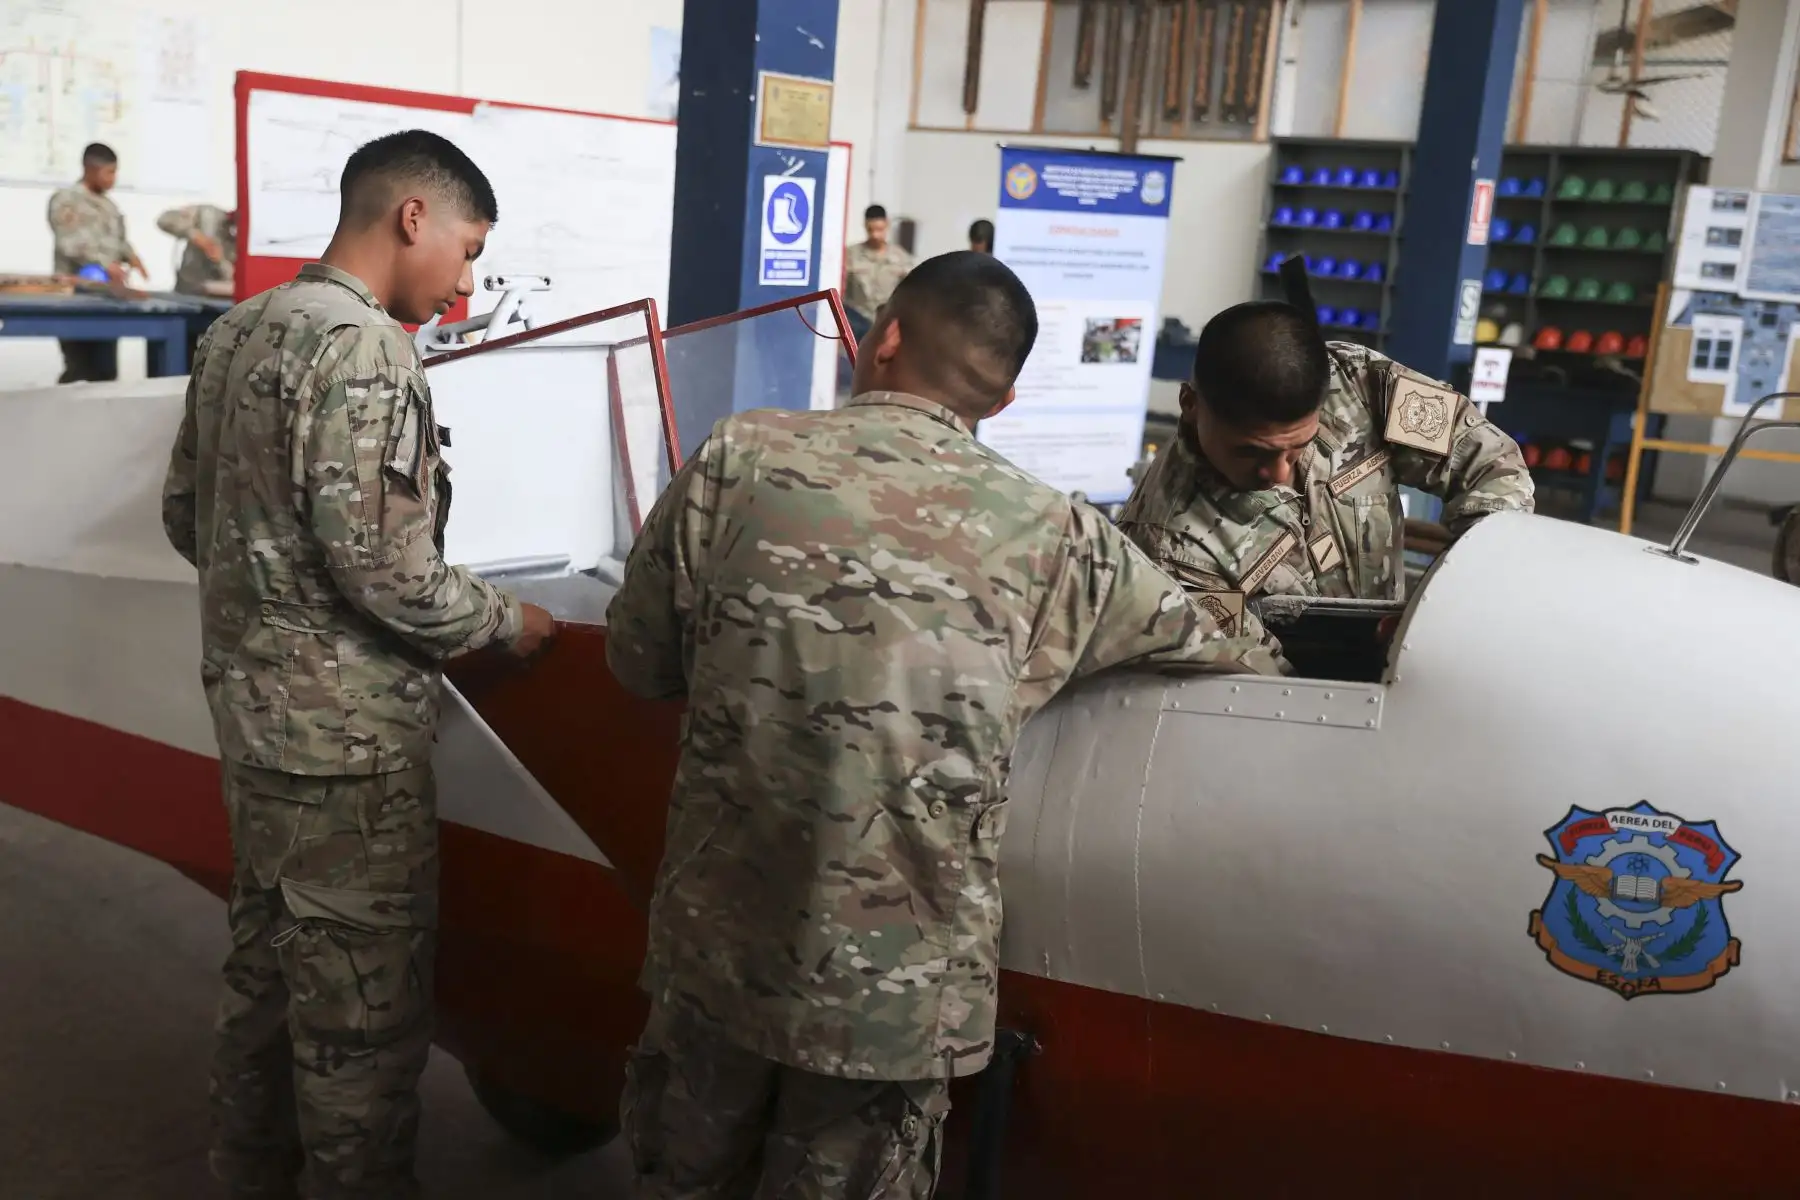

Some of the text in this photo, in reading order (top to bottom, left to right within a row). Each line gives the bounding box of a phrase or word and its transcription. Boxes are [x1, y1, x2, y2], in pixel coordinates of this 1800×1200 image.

[1333, 451, 1386, 491] FUERZA AERE
[1251, 547, 1284, 583] LEVERONI
[1610, 814, 1649, 828] AEREA
[1652, 818, 1675, 830] DEL
